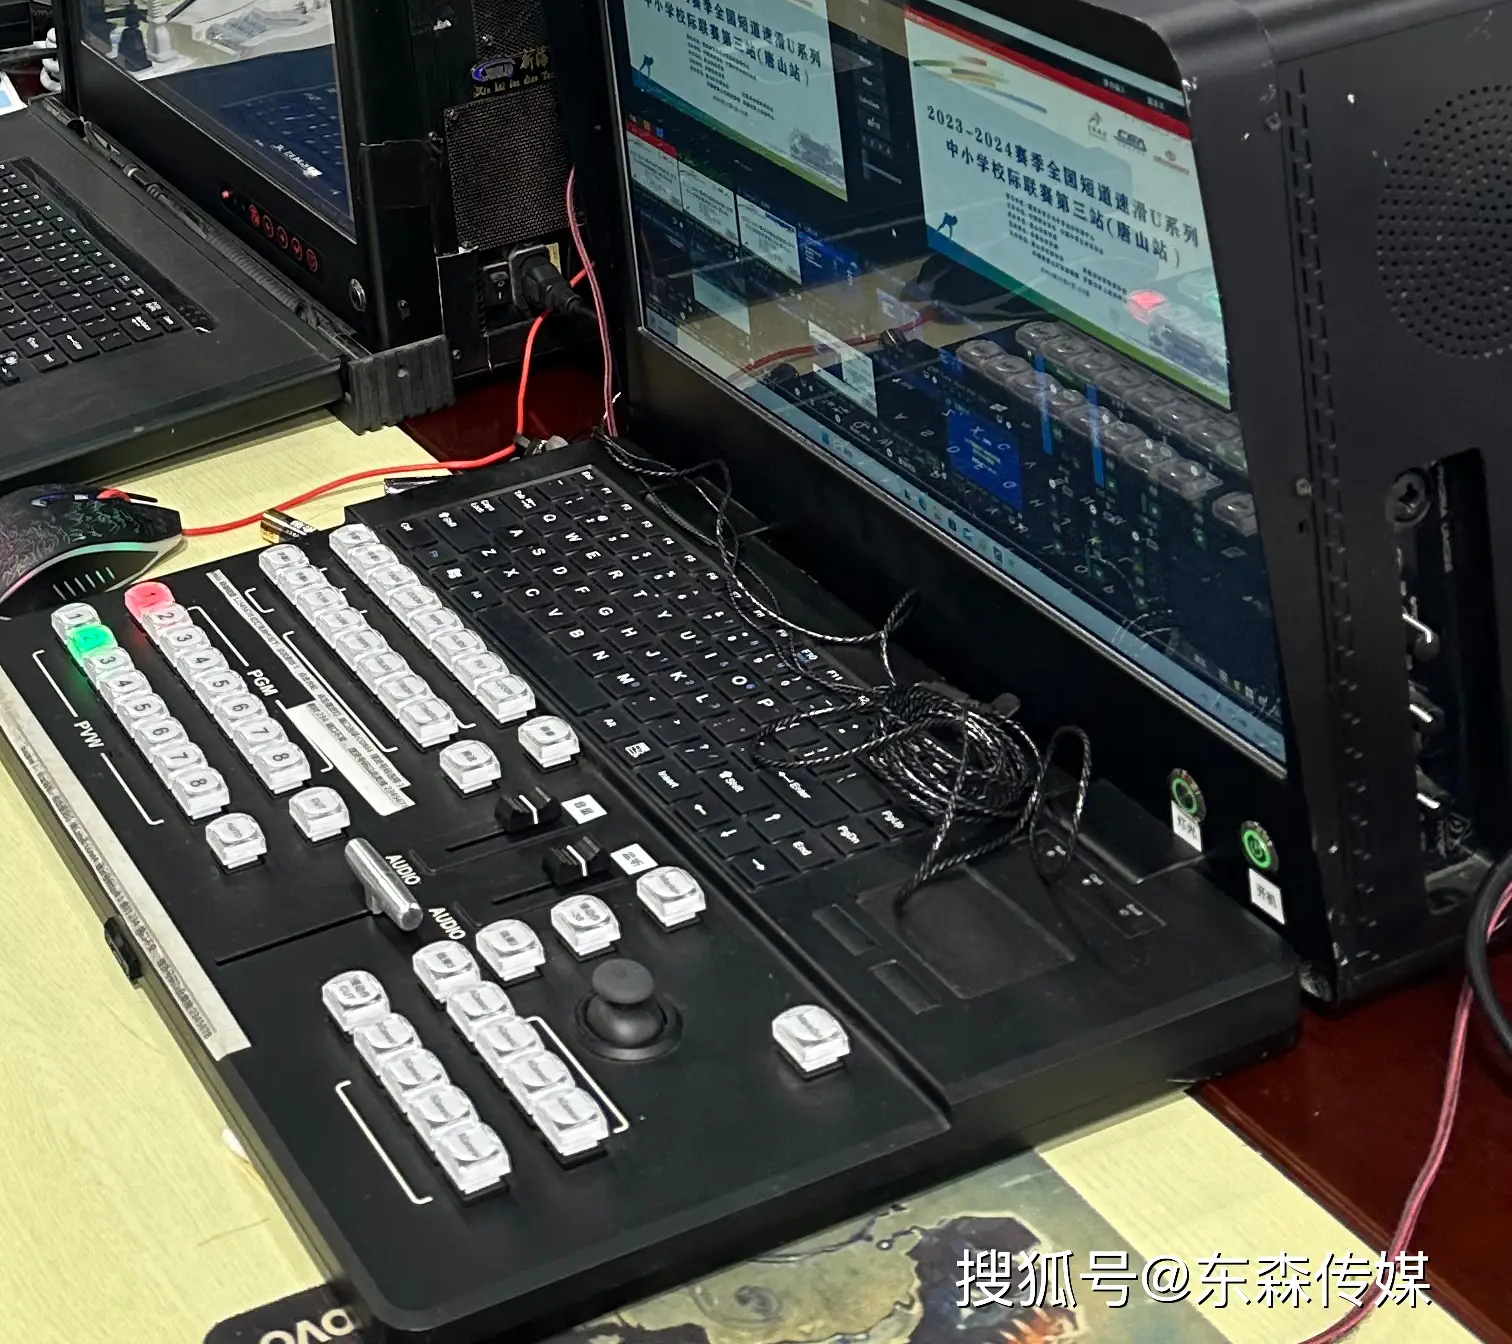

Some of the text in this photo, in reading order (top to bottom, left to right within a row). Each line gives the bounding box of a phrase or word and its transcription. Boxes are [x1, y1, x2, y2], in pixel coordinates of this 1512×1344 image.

[926, 105, 1200, 248] 2023-2024赛季全国短道速滑U系列
[543, 514, 556, 523] Q
[509, 529, 523, 538] A
[565, 532, 582, 543] W
[481, 548, 497, 557] Z
[532, 547, 546, 556] S
[586, 551, 601, 559] E
[503, 568, 519, 577] X
[553, 566, 568, 575] D
[608, 569, 624, 579] R
[525, 588, 540, 597] C
[575, 586, 590, 595] F
[633, 589, 648, 598] T
[548, 608, 563, 618] V
[598, 606, 614, 616] G
[658, 610, 672, 620] Y
[158, 612, 175, 622] 2
[569, 629, 584, 638] B
[621, 627, 637, 637] H
[680, 631, 696, 641] U
[177, 634, 193, 643] 3
[592, 651, 609, 661] N
[645, 650, 661, 658] J
[800, 649, 818, 661] F10
[99, 656, 117, 666] 3
[195, 656, 211, 665] 4
[616, 672, 635, 685] M
[670, 671, 687, 681] K
[731, 676, 747, 686] O
[117, 679, 133, 688] 4
[212, 679, 231, 689] 5
[247, 669, 279, 697] PGM
[696, 693, 709, 703] L
[757, 698, 774, 708] P
[133, 702, 151, 713] 5
[232, 702, 249, 713] 6
[74, 720, 105, 749] PVW
[153, 726, 169, 737] 6
[251, 726, 269, 737] 7
[170, 751, 189, 761] 7
[272, 753, 290, 762] 8
[190, 778, 207, 788] 8
[384, 853, 421, 887] AUDIO
[1256, 882, 1278, 910] 开机
[428, 906, 467, 941] AUDIO
